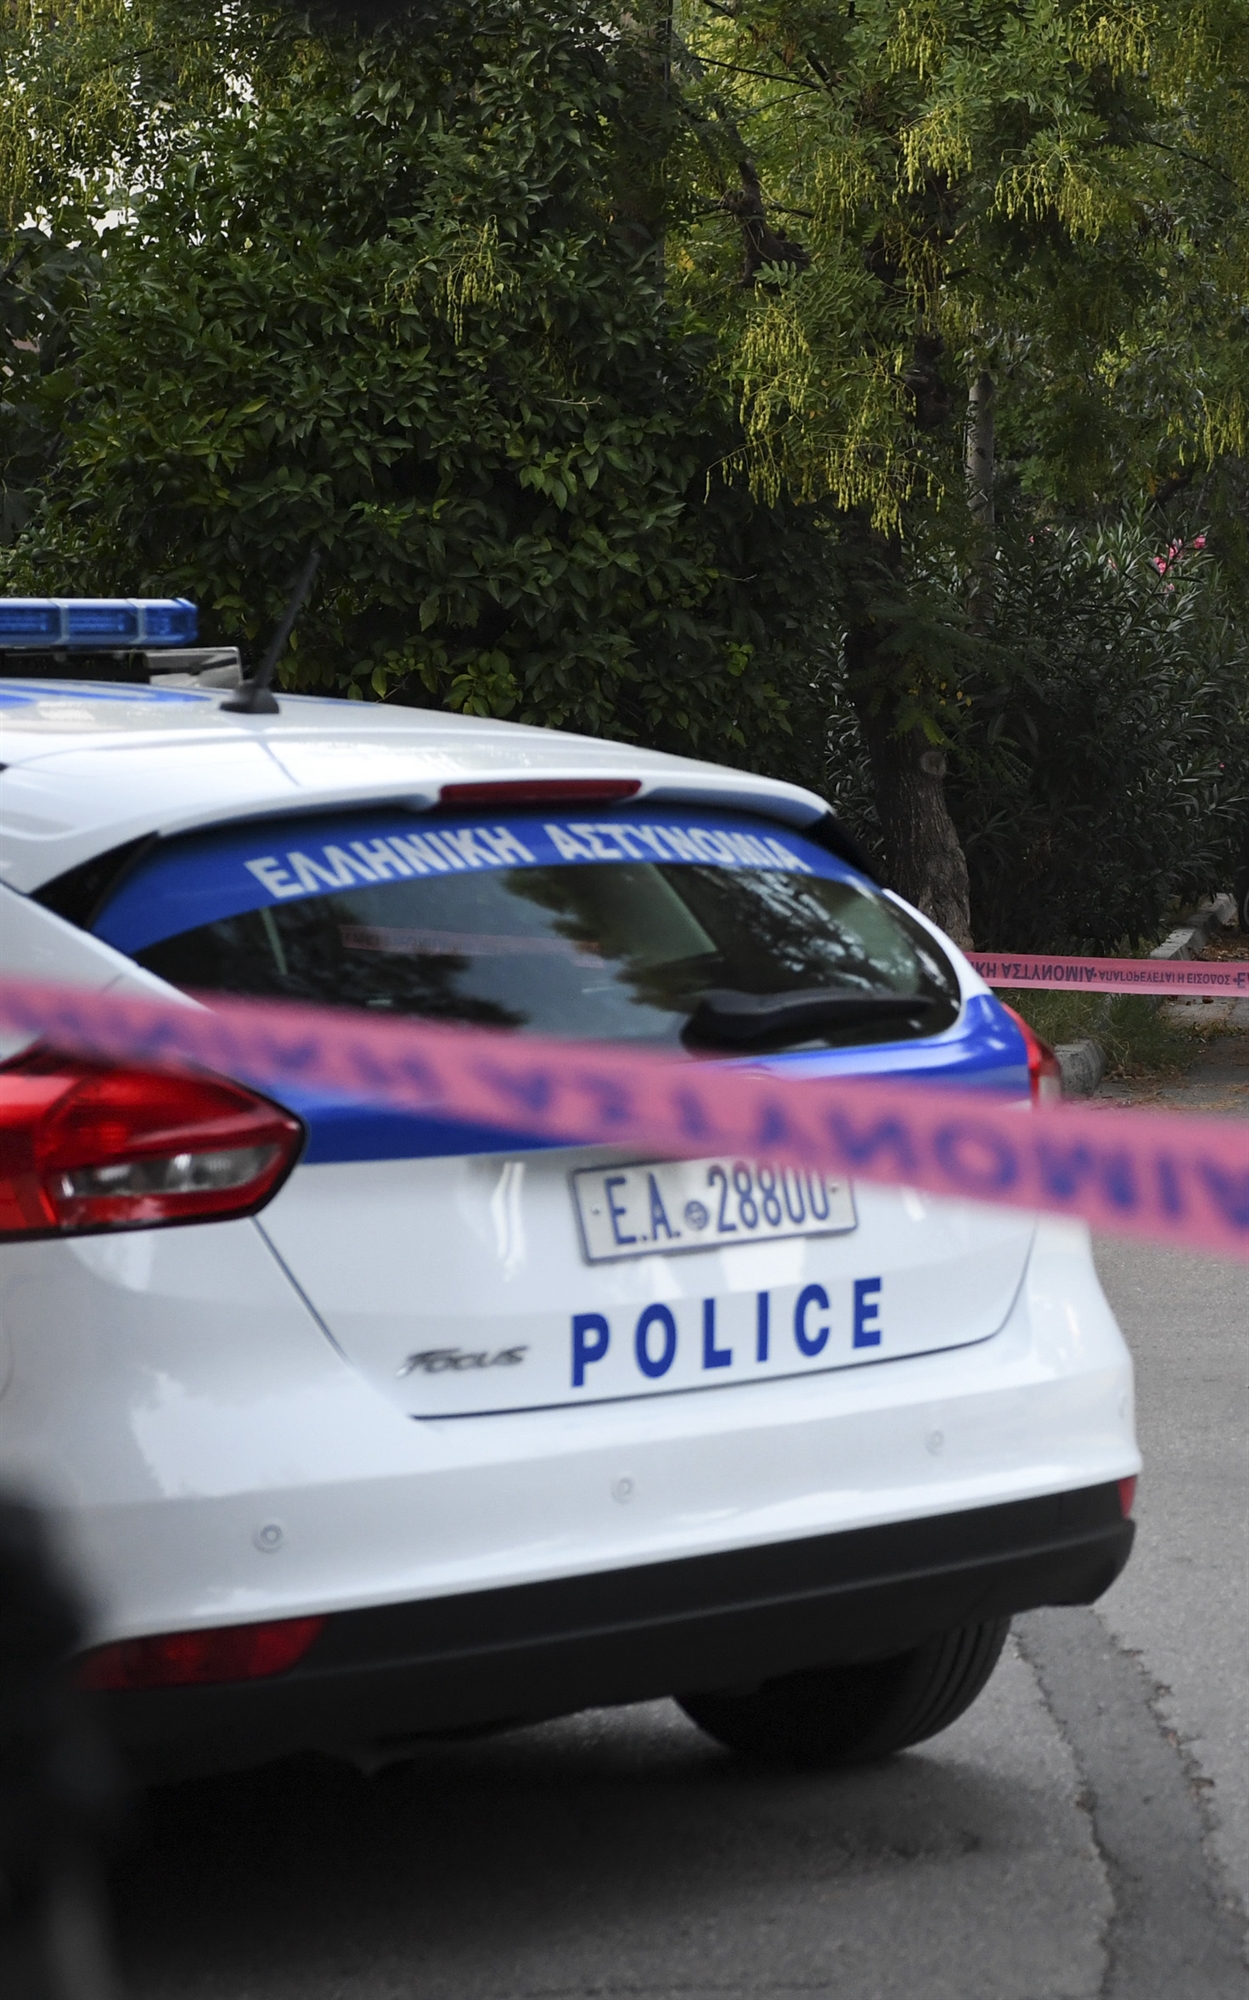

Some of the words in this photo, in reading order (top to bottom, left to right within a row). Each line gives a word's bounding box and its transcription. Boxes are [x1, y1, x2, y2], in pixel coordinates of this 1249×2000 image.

[244, 826, 536, 900] ΕΛΛΗΝΙΚΗ
[542, 822, 812, 874] ΑΣΤΥΝΟΜΙΑ
[708, 1161, 830, 1232] 28800
[571, 1277, 883, 1387] POLICE
